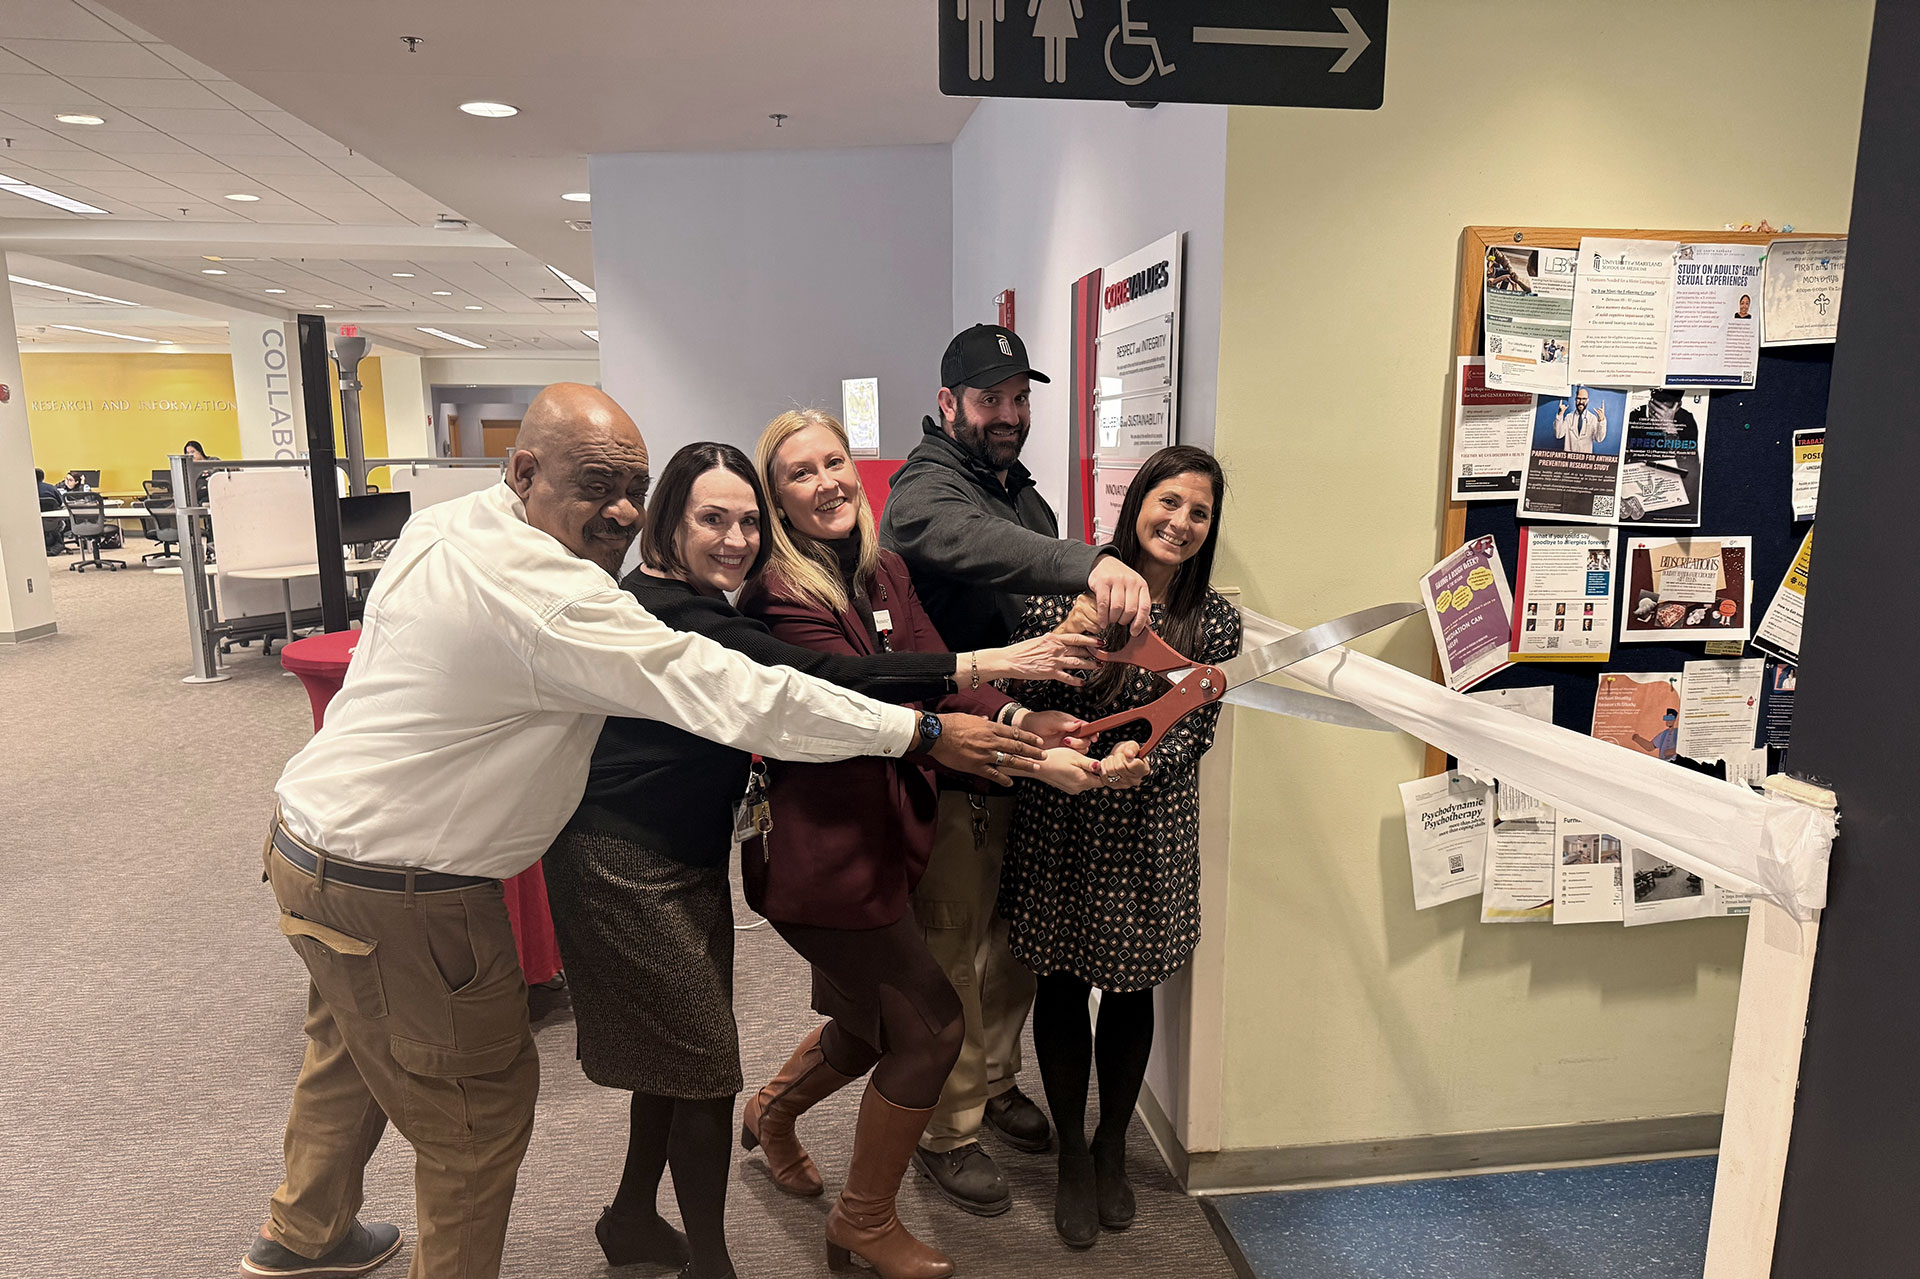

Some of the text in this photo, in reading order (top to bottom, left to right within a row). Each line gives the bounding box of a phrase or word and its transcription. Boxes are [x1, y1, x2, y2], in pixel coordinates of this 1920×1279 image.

[1602, 258, 1631, 266] UNIVEITY
[1794, 263, 1815, 272] FIRST
[1677, 264, 1701, 275] STUDY
[1702, 264, 1713, 275] ON
[1742, 265, 1760, 277] EARLY
[1677, 275, 1748, 287] SEXUAL EXPERIENCES
[1803, 275, 1839, 284] MONDAYS
[1116, 341, 1136, 358] RESPECT
[1141, 333, 1167, 351] INTEGRITY
[31, 400, 237, 412] RESEARCH AND INFORMATION
[1127, 412, 1164, 427] SUSTAINABILITY
[1630, 437, 1697, 449] PRESCRIBED
[1531, 450, 1567, 459] PARTICIPANTS
[1567, 453, 1585, 461] NEEDED
[1595, 455, 1618, 463] ANTHRAX
[1538, 459, 1610, 471] PREVENTION RESEARCH STUDY
[1105, 483, 1128, 497] INNOVATIO
[1462, 556, 1480, 571] WEEK?
[1470, 614, 1483, 625] CAN
[1421, 798, 1484, 822] Psychodynamic
[1424, 807, 1483, 830] Psychotherapy
[1469, 817, 1486, 825] advice
[1458, 824, 1475, 832] coping
